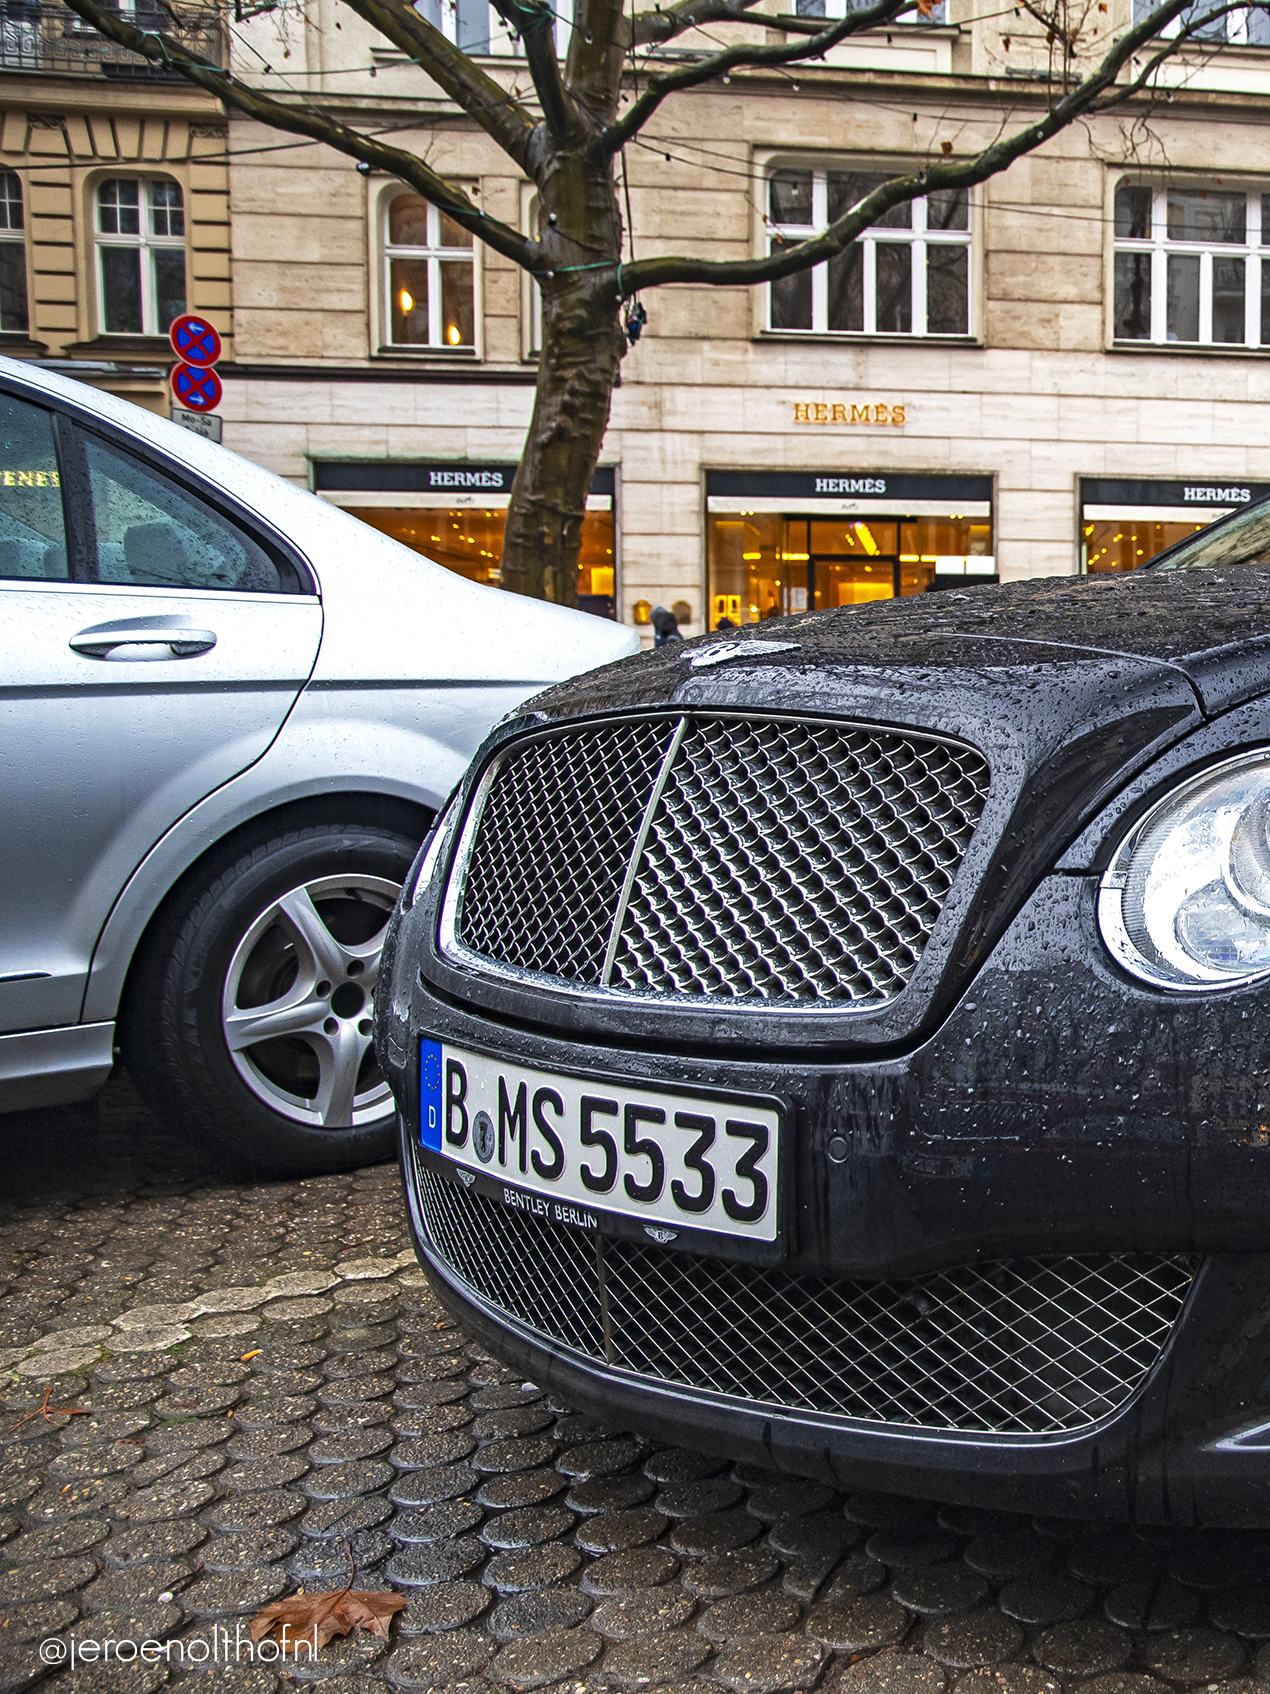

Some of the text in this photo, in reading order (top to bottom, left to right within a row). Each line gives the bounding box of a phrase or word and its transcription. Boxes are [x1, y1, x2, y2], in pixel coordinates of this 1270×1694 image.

[428, 1105, 437, 1129] D
[445, 1057, 770, 1224] B MS 5533
[503, 1188, 598, 1229] BENTLEY BERLIN
